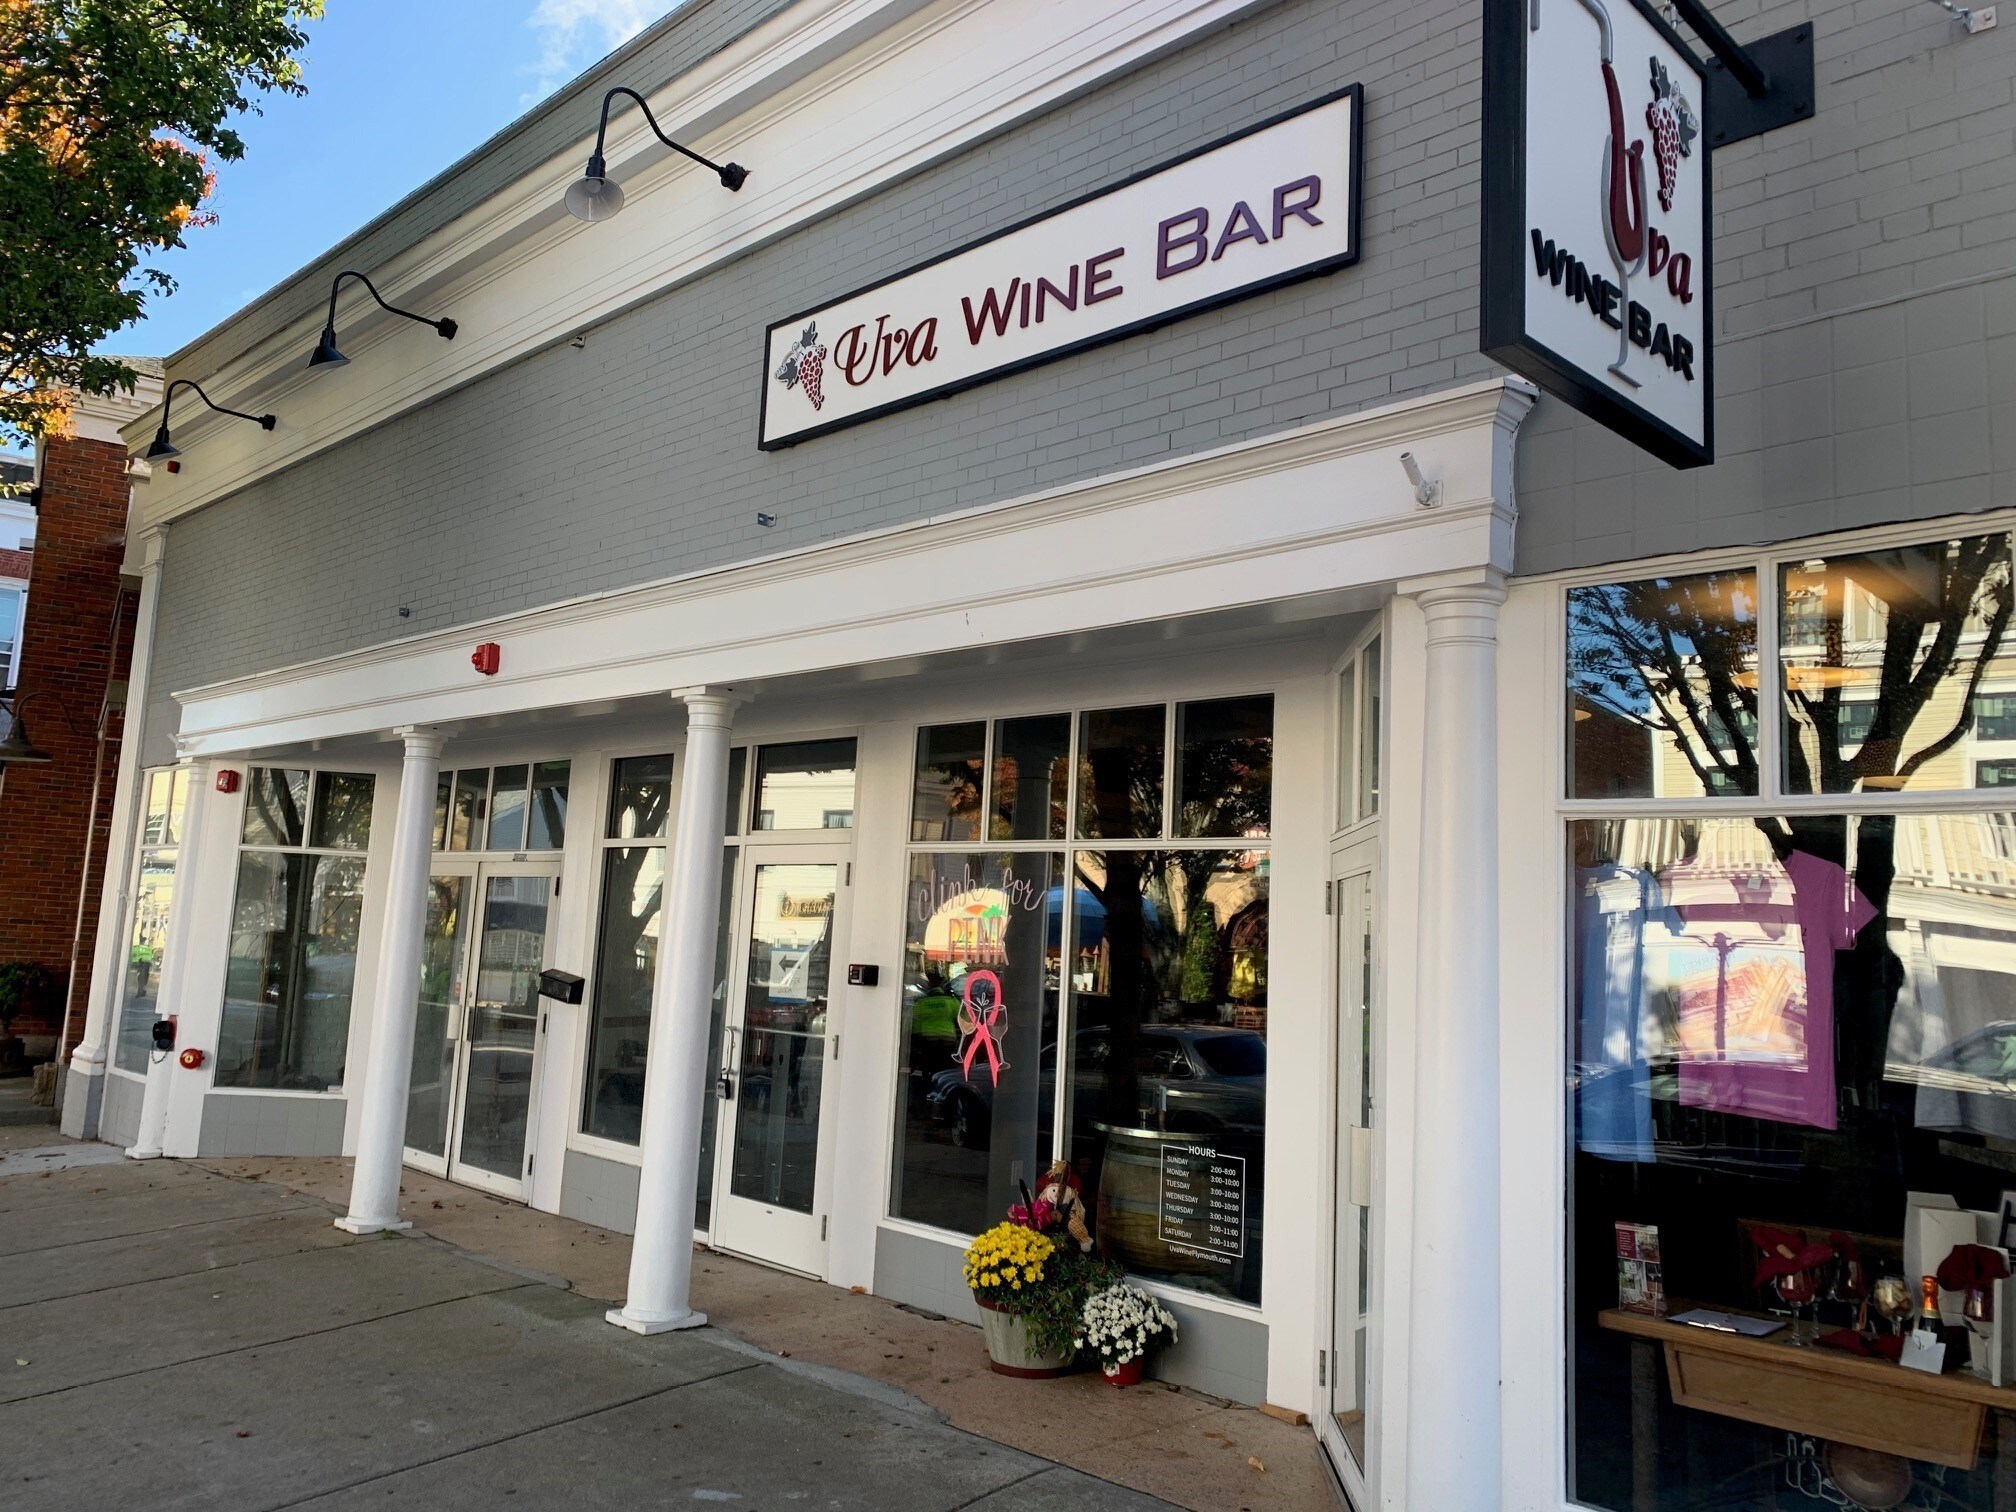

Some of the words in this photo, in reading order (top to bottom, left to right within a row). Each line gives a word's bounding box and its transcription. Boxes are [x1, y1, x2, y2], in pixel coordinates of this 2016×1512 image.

[832, 313, 938, 387] Uva
[960, 246, 1126, 346] WINE
[1156, 174, 1324, 281] BAR
[1531, 228, 1623, 330] WINE
[1629, 301, 1694, 382] BAR
[999, 867, 1047, 913] for
[947, 914, 1013, 966] PINK
[1188, 1145, 1215, 1158] HOURS
[1166, 1156, 1188, 1165] SUNDAY
[1166, 1168, 1189, 1177] MONDAY
[1166, 1179, 1190, 1189] TUESDAY
[1165, 1191, 1198, 1203] WEDNESDAY
[1165, 1203, 1193, 1214] THURSDAY
[1165, 1215, 1183, 1224] FRIDAY
[1164, 1227, 1192, 1238] SATURDAY
[1169, 1245, 1231, 1264] UvaWinePlymouth.com
